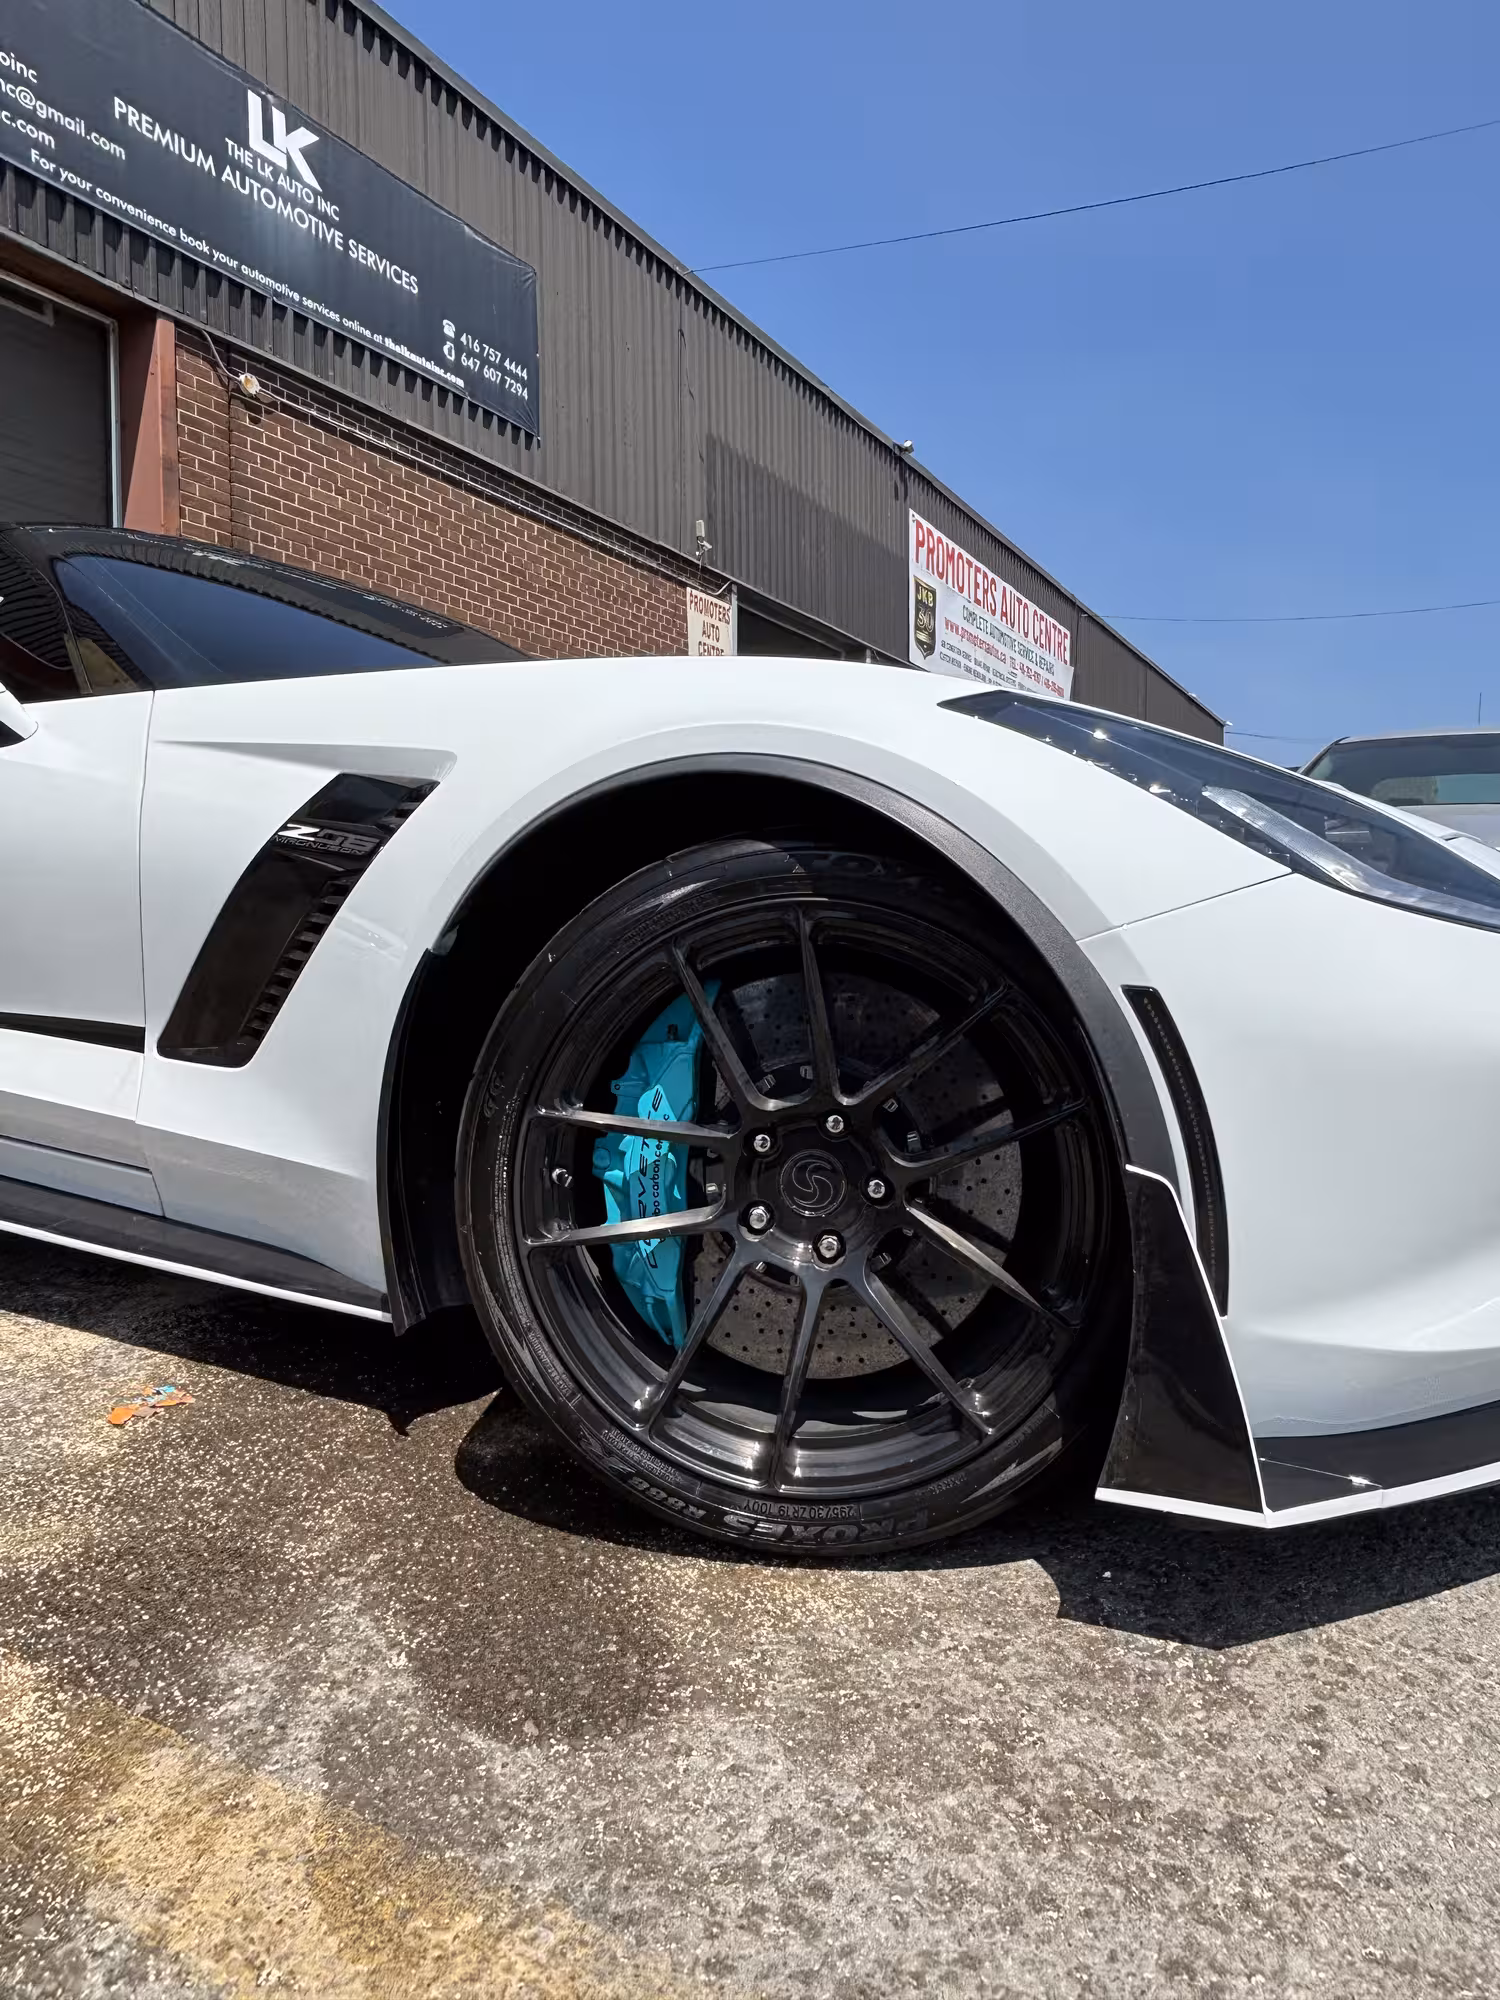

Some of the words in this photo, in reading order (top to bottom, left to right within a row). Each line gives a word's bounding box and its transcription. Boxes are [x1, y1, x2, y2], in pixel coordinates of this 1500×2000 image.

[247, 88, 322, 192] LK
[113, 96, 216, 177] PREMIUM
[221, 164, 344, 251] AUTOMOTIVE
[348, 238, 419, 295] SERVICES
[225, 137, 253, 169] THE
[257, 158, 274, 182] LK
[277, 172, 315, 204] AUTO
[317, 195, 340, 221] INC
[31, 147, 56, 172] For
[59, 167, 93, 192] your
[95, 187, 176, 237] convenience
[179, 228, 210, 255] book
[212, 248, 239, 269] your
[241, 264, 300, 302] automotive
[302, 296, 340, 322] services
[342, 317, 372, 338] online
[373, 332, 383, 343] at
[384, 336, 465, 389] thelkautoinc.com
[460, 332, 480, 353] 416
[482, 343, 502, 364] 757
[503, 357, 528, 381] 4444
[460, 352, 480, 373] 647
[483, 364, 502, 385] 607
[504, 375, 528, 401] 7294
[689, 591, 732, 625] PROMOTERS
[914, 519, 997, 617] PROMOTERS
[1000, 585, 1030, 638] AUTO
[1032, 608, 1069, 666] CENTRE
[702, 619, 720, 643] AUTO
[962, 604, 989, 635] COMPLETE
[273, 834, 365, 855] MAGNUSON
[277, 823, 381, 849] Z06
[652, 1159, 661, 1198] carbon
[808, 1503, 858, 1519] 295/30
